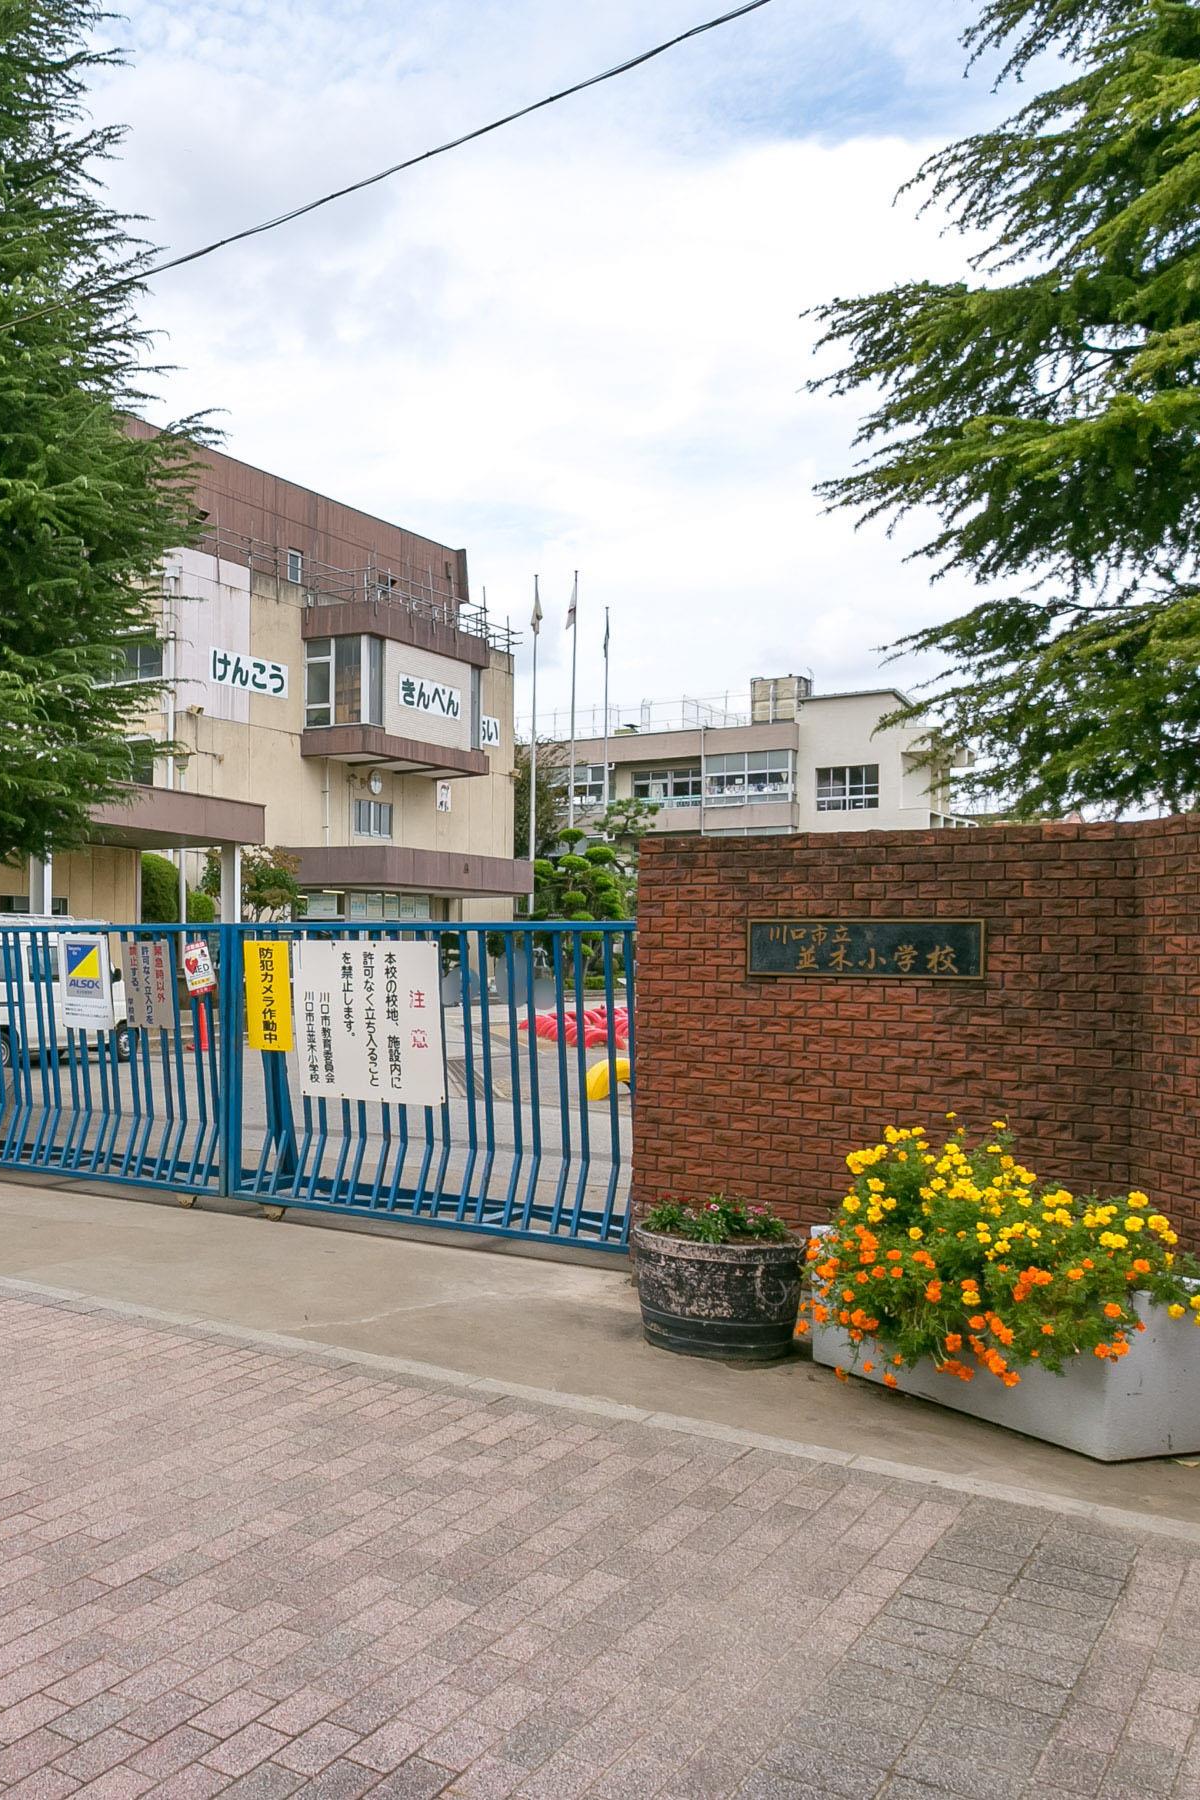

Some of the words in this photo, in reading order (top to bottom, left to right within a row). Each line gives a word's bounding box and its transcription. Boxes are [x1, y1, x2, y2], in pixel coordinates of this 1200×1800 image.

[212, 650, 285, 694] けんこう
[402, 677, 459, 717] きんべん
[769, 924, 852, 946] 川口市立
[795, 944, 959, 975] 並木小学校
[69, 979, 101, 989] ALSOK
[141, 946, 154, 1025] 許可なく立入りを
[153, 945, 167, 1004] 緊急時以外
[258, 947, 278, 1045] 防犯カメラ作動中
[340, 951, 356, 1038] を禁止します。
[304, 991, 321, 1084] 川口市立並木小学校
[319, 992, 336, 1084] 川口市教育委員会
[362, 951, 380, 1088] 許可なく立ち入ること
